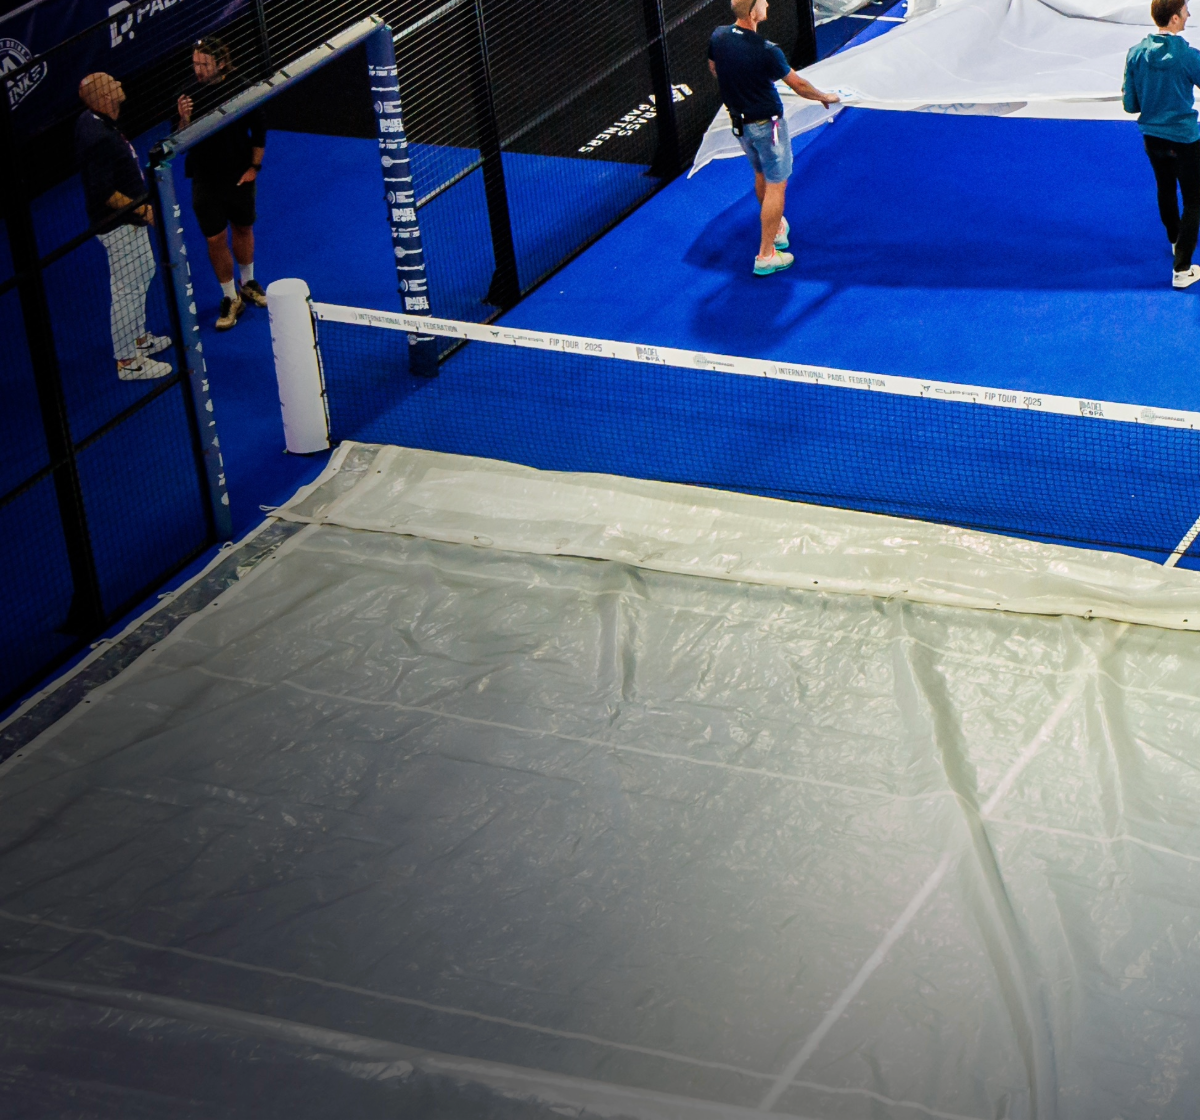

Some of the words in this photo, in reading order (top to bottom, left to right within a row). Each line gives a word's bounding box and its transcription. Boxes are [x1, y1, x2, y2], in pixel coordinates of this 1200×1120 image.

[358, 312, 401, 326] INTERNATIONAL
[404, 318, 422, 328] PADEL
[423, 322, 458, 333] FEDERATION
[549, 337, 560, 347] FIP
[562, 339, 579, 350] TOUR
[584, 342, 603, 353] 2025
[778, 367, 824, 381] INTERNATIONAL
[827, 373, 845, 383] PADEL
[848, 375, 886, 388] FEDERATION
[984, 391, 996, 401] FIP
[998, 392, 1017, 404] TOUR
[1023, 396, 1042, 407] 2025
